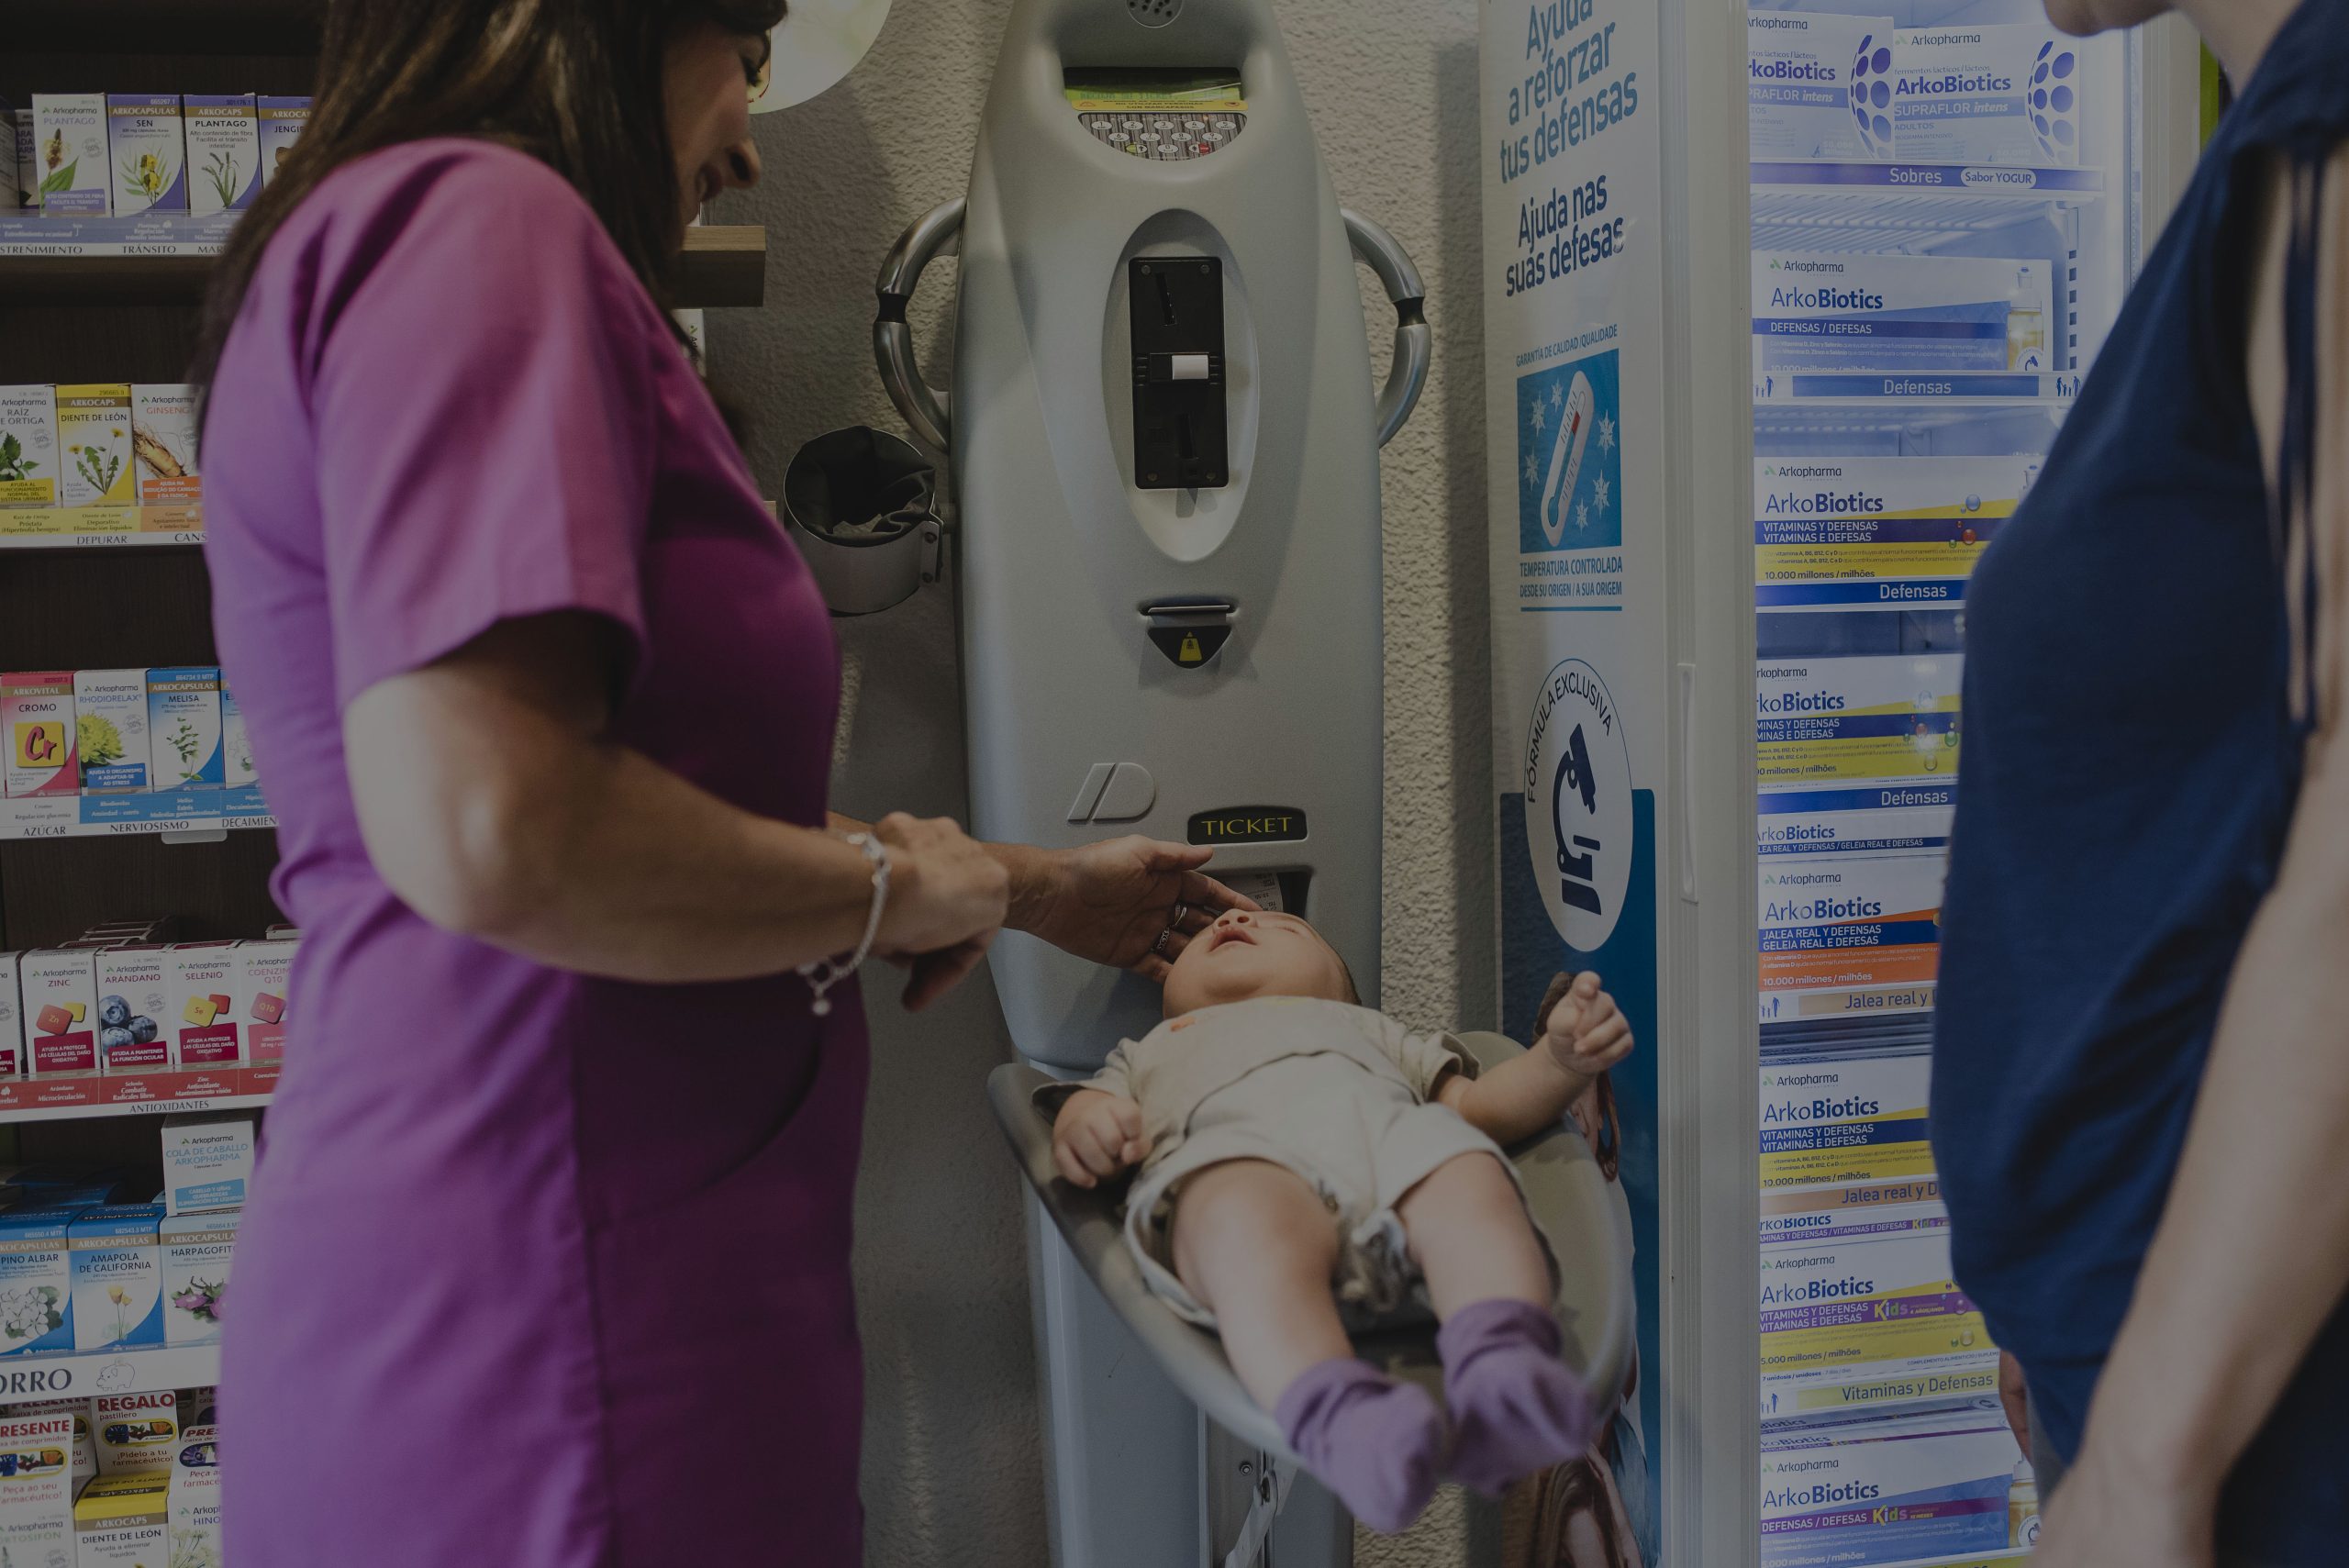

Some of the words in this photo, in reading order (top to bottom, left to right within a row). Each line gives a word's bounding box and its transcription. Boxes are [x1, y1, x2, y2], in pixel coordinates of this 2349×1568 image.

[1527, 0, 1593, 63] Ayuda
[1911, 33, 1980, 46] Arkopharma
[1509, 87, 1520, 126] a
[1525, 22, 1616, 117] reforzar
[1895, 72, 2011, 95] ArkoBiotics
[1802, 90, 1833, 103] intens
[112, 107, 175, 116] ARKOCAPSULAS
[198, 107, 242, 116] ARKOCAPS
[1895, 102, 1970, 117] SUPRAFLOR
[1974, 102, 2008, 113] intens
[43, 117, 95, 126] PLANTAGO
[136, 119, 153, 128] SEN
[1500, 136, 1530, 184] tus
[1534, 72, 1638, 166] defensas
[1895, 122, 1934, 130] ADULTOS
[1889, 168, 1943, 183] Sobres
[1965, 172, 1993, 183] Sabor
[1995, 172, 2032, 183] YOGUR
[1519, 187, 1567, 253] Ajuda
[1573, 174, 1607, 222] nas
[121, 243, 176, 254] TRÁNSITO
[1507, 250, 1545, 296] suas
[1550, 217, 1624, 280] defesas
[1784, 260, 1843, 273] Arkopharma
[1771, 286, 1883, 309] ArkoBiotics
[1770, 322, 1820, 333] DEFENSAS
[1829, 323, 1872, 335] DEFESAS
[1516, 345, 1544, 367] GARANTÍA
[1545, 346, 1553, 361] DE
[1553, 336, 1579, 357] CALIDAD
[1884, 379, 1952, 395] Defensas
[71, 398, 116, 406] ARKOCAPS
[7, 408, 29, 417] RAÍZ
[61, 414, 90, 422] DIENTE
[105, 412, 128, 421] LEÓN
[1778, 465, 1842, 478] Arkopharma
[1765, 492, 1884, 514] ArkoBiotics
[1764, 522, 1817, 532] VITAMINAS
[1827, 521, 1878, 531] DEFENSAS
[77, 535, 128, 545] DEPURAR
[1764, 533, 1817, 543] VITAMINAS
[1827, 532, 1871, 542] DEFESAS
[1520, 559, 1569, 577] TEMPERATURA
[1570, 556, 1623, 575] CONTROLADA
[1765, 571, 1796, 580] 10.000
[1798, 570, 1834, 579] millones
[1841, 569, 1875, 578] milhões
[1520, 584, 1539, 597] DESDE
[1540, 584, 1547, 596] SU
[1548, 583, 1572, 596] ORIGEN
[1575, 584, 1580, 595] A
[1581, 583, 1594, 596] SUA
[1596, 582, 1622, 595] ORIGEM
[1880, 584, 1947, 600] Defensas
[13, 687, 60, 696] ARKOVITAL
[95, 684, 139, 693] Arkopharma
[152, 682, 215, 691] ARKOCAPSULAS
[168, 695, 200, 703] MELISA
[18, 703, 57, 713] CROMO
[1528, 690, 1555, 803] FÓRMULA
[1554, 672, 1611, 737] EXCLUSIVA
[1881, 791, 1948, 806] Defensas
[23, 824, 66, 836] AZÚCAR
[110, 820, 189, 833] NERVIOSISMO
[1201, 817, 1292, 836] TICKET
[1779, 873, 1842, 885] Arkopharma
[1765, 896, 1881, 921] ArkoBiotics
[1763, 930, 1794, 940] JALEA
[1796, 929, 1820, 939] REAL
[1831, 925, 1882, 936] DEFENSAS
[1763, 940, 1798, 951] GELEIA
[1800, 939, 1824, 949] REAL
[1835, 936, 1879, 947] DEFESAS
[116, 964, 160, 973] Arkopharma
[188, 962, 230, 970] Arkopharma
[42, 969, 87, 977] Arkopharma
[105, 973, 161, 984] ARÁNDANO
[185, 971, 223, 980] SELENIO
[1763, 977, 1794, 986] 10.000
[1796, 976, 1831, 984] millones
[1838, 972, 1873, 982] milhões
[48, 979, 71, 987] ZINC
[1844, 995, 1883, 1009] Jalea
[1887, 991, 1916, 1006] real
[1776, 1073, 1839, 1086] Arkopharma
[129, 1100, 210, 1114] ANTIOXIDANTES
[1764, 1095, 1879, 1123] ArkoBiotics
[1762, 1129, 1814, 1141] VITAMINAS
[1824, 1124, 1874, 1137] DEFENSAS
[192, 1135, 234, 1144] Arkopharma
[1762, 1140, 1814, 1152] VITAMINAS
[1825, 1135, 1867, 1147] DEFESAS
[166, 1149, 191, 1157] COLA
[193, 1147, 204, 1155] DE
[206, 1143, 248, 1153] CABALLO
[175, 1153, 240, 1165] ARKOPHARMA
[1842, 1188, 1880, 1204] Jalea
[1884, 1184, 1912, 1199] real
[78, 1237, 149, 1248] ARKOCAPSULAS
[2, 1255, 25, 1264] PINO
[28, 1253, 59, 1262] ALBAR
[91, 1252, 139, 1263] AMAPOLA
[1776, 1255, 1835, 1269] Arkopharma
[94, 1262, 151, 1273] CALIFORNIA
[1761, 1276, 1874, 1305] ArkoBiotics
[1760, 1311, 1809, 1322] VITAMINAS
[1820, 1303, 1868, 1316] DEFENSAS
[1874, 1299, 1908, 1321] Kids
[1760, 1321, 1809, 1333] VITAMINAS
[1820, 1314, 1862, 1326] DEFESAS
[1761, 1355, 1786, 1365] 5.000
[1787, 1353, 1821, 1363] millones
[1828, 1348, 1861, 1358] milhões
[1842, 1383, 1913, 1402] Vitaminas
[1929, 1374, 1993, 1392] Defensas
[97, 1394, 175, 1412] REGALO
[44, 1405, 88, 1416] comprimidos
[99, 1412, 137, 1421] pastillero
[112, 1456, 173, 1467] farmacéutico!
[1776, 1460, 1839, 1473] Arkopharma
[1763, 1481, 1879, 1508] ArkoBiotics
[95, 1516, 147, 1529] ARKOCAPS
[1762, 1520, 1813, 1533] DEFENSAS
[1822, 1514, 1866, 1527] DEFESAS
[1873, 1505, 1908, 1527] Kids
[8, 1520, 63, 1533] Arkopharma
[82, 1534, 117, 1544] DIENTE
[135, 1529, 161, 1540] LEÓN
